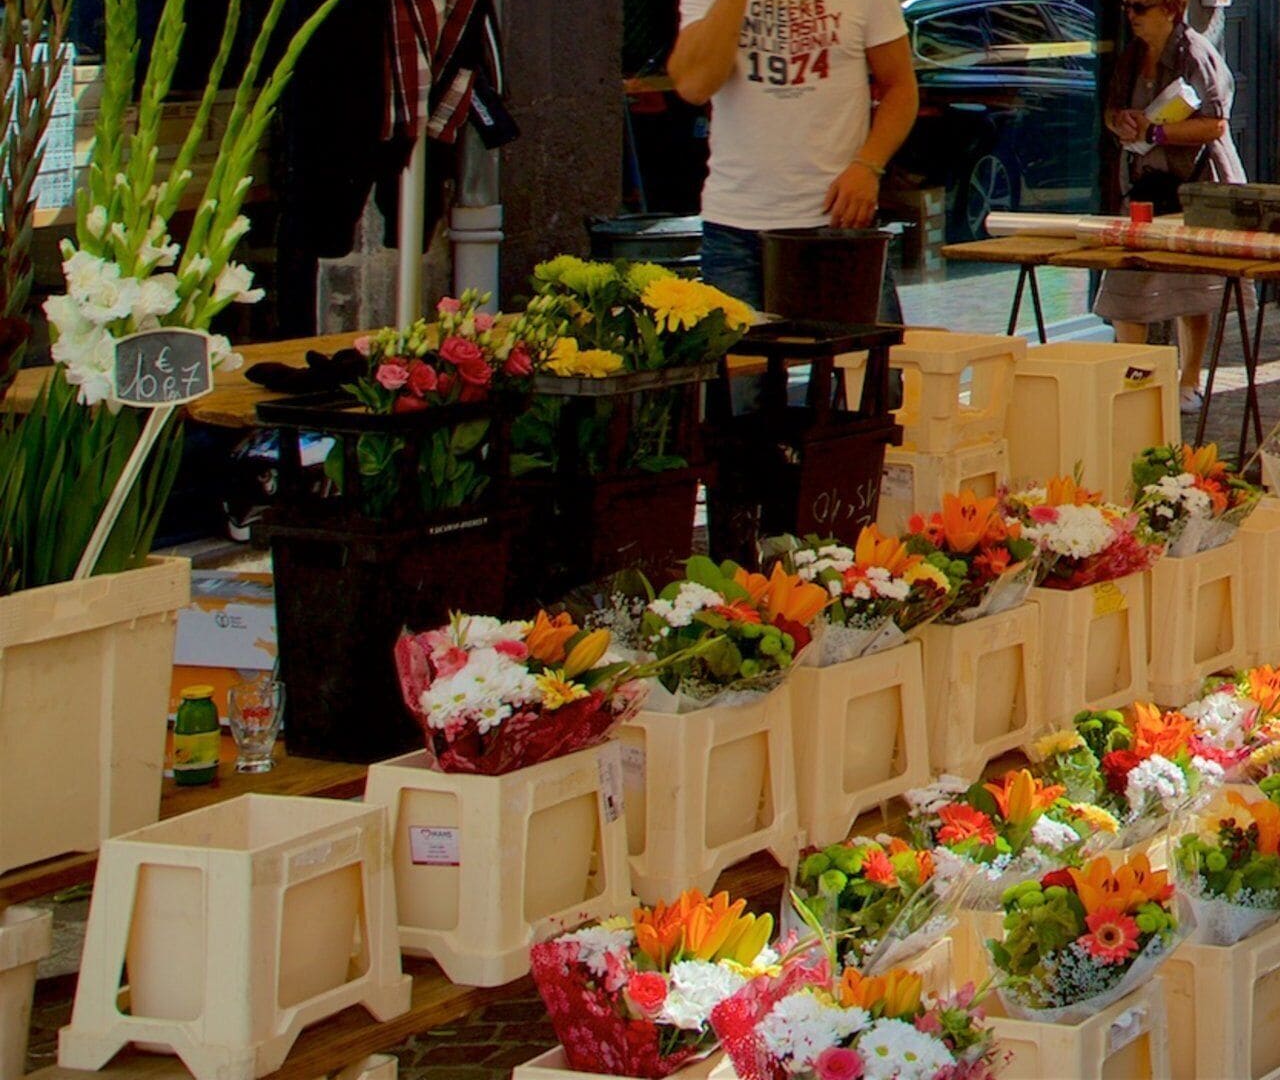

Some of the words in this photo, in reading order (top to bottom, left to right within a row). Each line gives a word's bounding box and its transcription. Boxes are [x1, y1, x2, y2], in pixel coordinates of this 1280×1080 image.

[741, 12, 842, 39] NIVERSITY
[747, 49, 829, 86] 1974
[181, 361, 200, 397] 7
